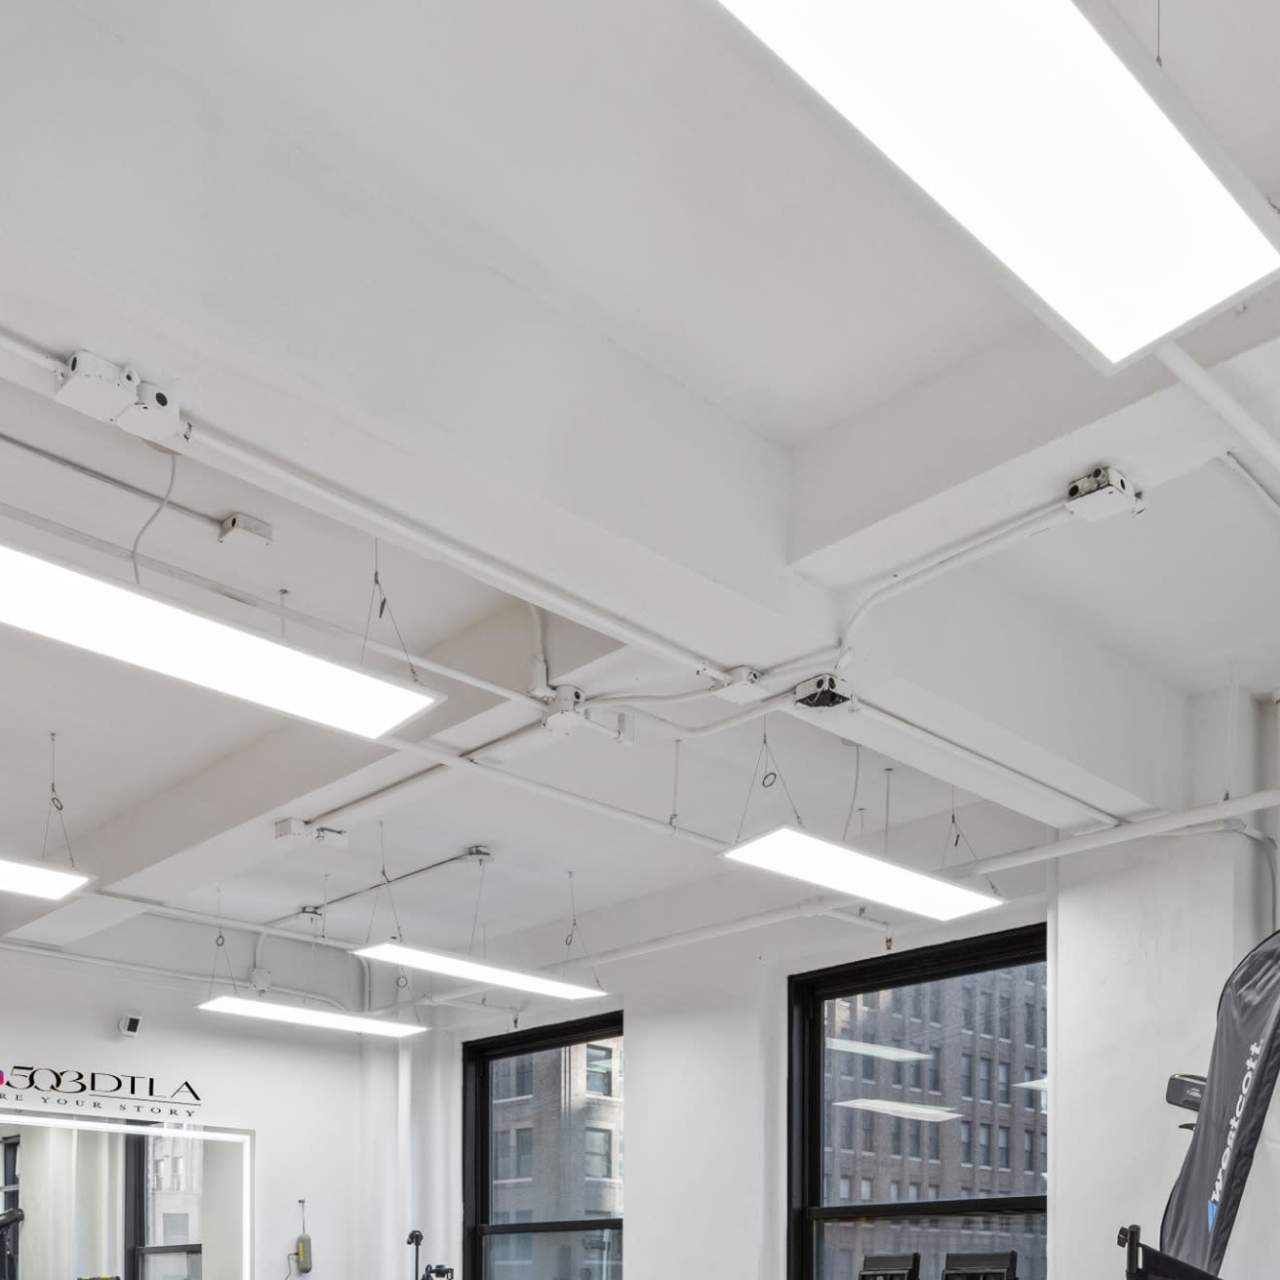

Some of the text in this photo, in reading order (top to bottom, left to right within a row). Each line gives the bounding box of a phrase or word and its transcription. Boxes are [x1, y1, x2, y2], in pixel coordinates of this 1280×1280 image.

[41, 1096, 103, 1110] YOUR
[119, 1103, 195, 1118] STORY
[1210, 1041, 1262, 1202] westcott
